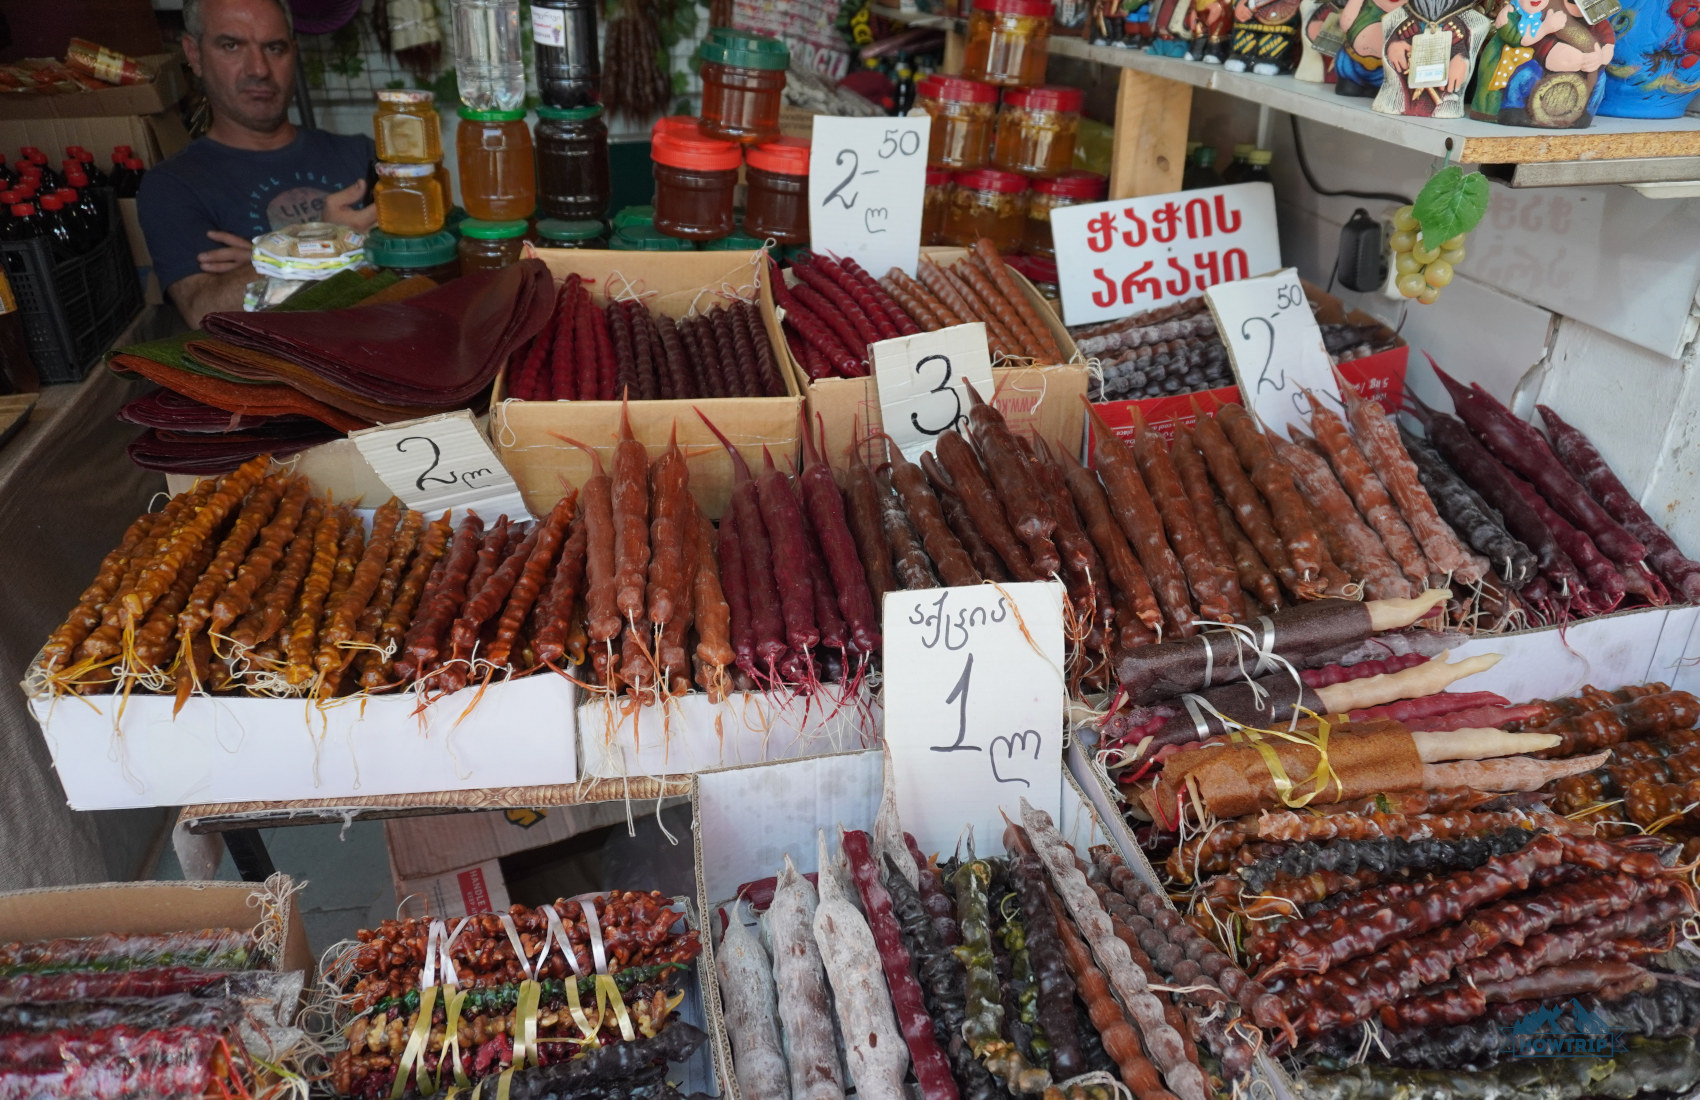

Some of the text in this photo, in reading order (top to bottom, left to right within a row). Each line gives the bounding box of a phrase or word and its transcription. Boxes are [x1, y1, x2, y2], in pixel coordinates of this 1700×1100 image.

[1087, 194, 1242, 253] ჭაჭის
[1091, 247, 1250, 308] არაყი
[911, 354, 961, 436] 3
[396, 436, 458, 491] 2
[930, 652, 982, 752] 1
[470, 869, 487, 907] HANDLE
